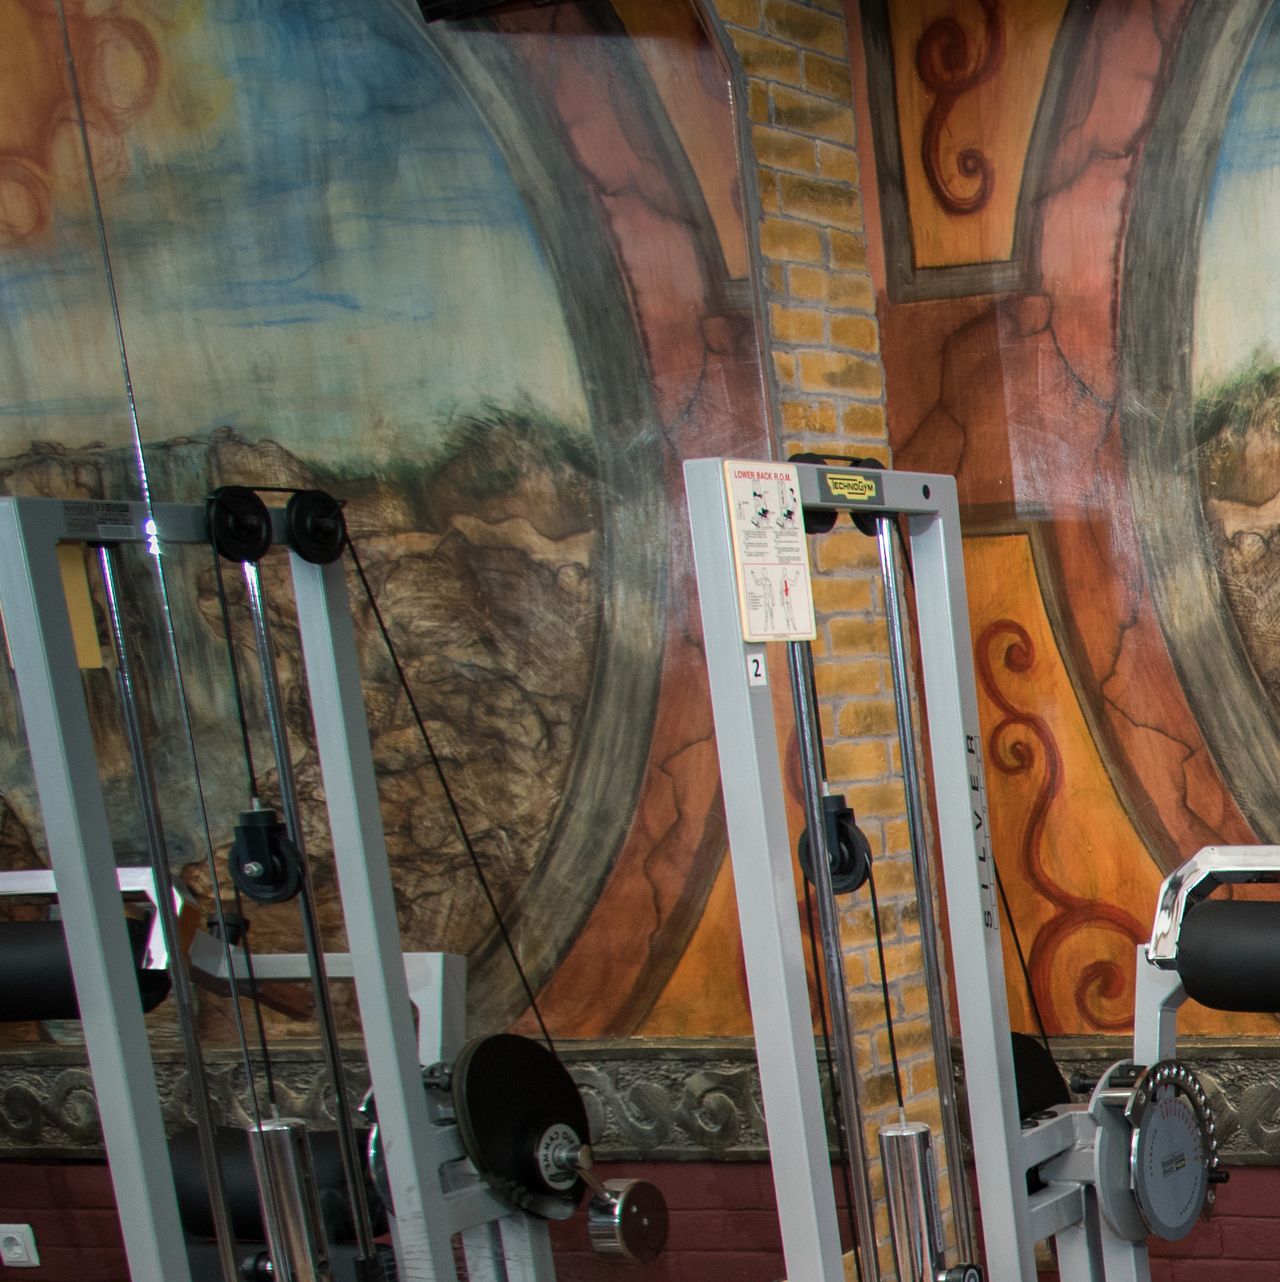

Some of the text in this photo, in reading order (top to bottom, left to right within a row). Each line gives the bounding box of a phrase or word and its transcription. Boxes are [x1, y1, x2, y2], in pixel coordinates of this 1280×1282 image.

[734, 470, 792, 482] LOWER BACK R.O.M.
[829, 477, 874, 496] TECHNOGYM
[752, 659, 762, 678] 2
[967, 734, 993, 929] SILVER
